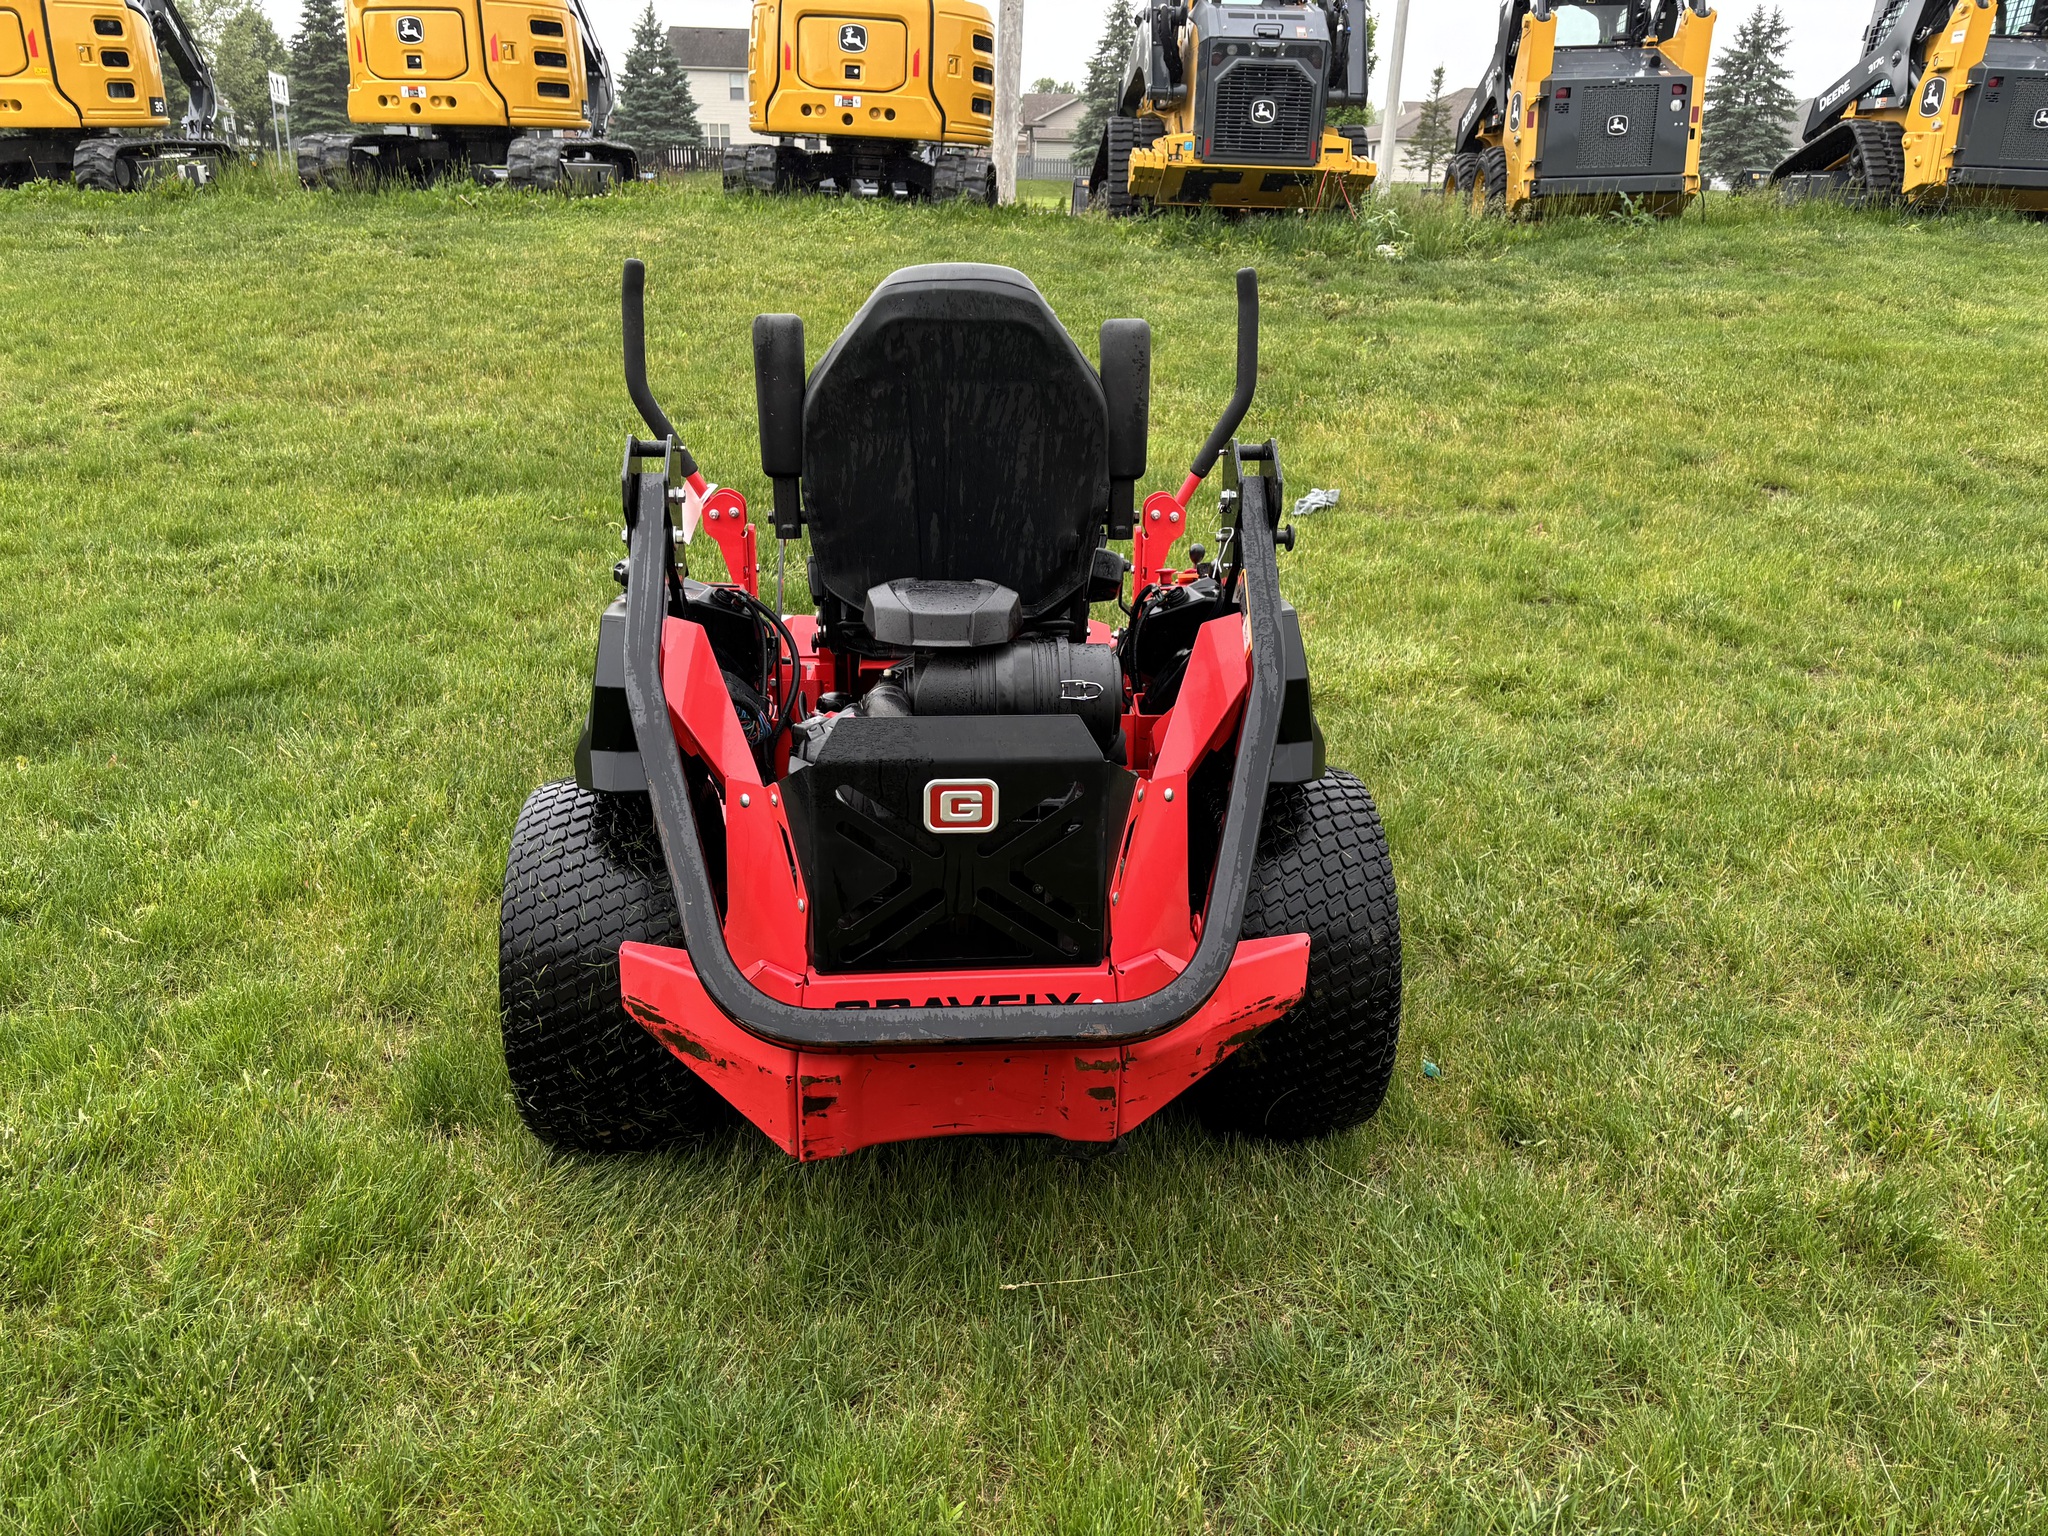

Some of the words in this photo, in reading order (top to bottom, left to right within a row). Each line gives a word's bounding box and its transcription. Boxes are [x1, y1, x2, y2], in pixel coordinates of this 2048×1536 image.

[154, 101, 164, 113] 35
[1819, 79, 1851, 112] DEERE
[940, 790, 982, 822] G
